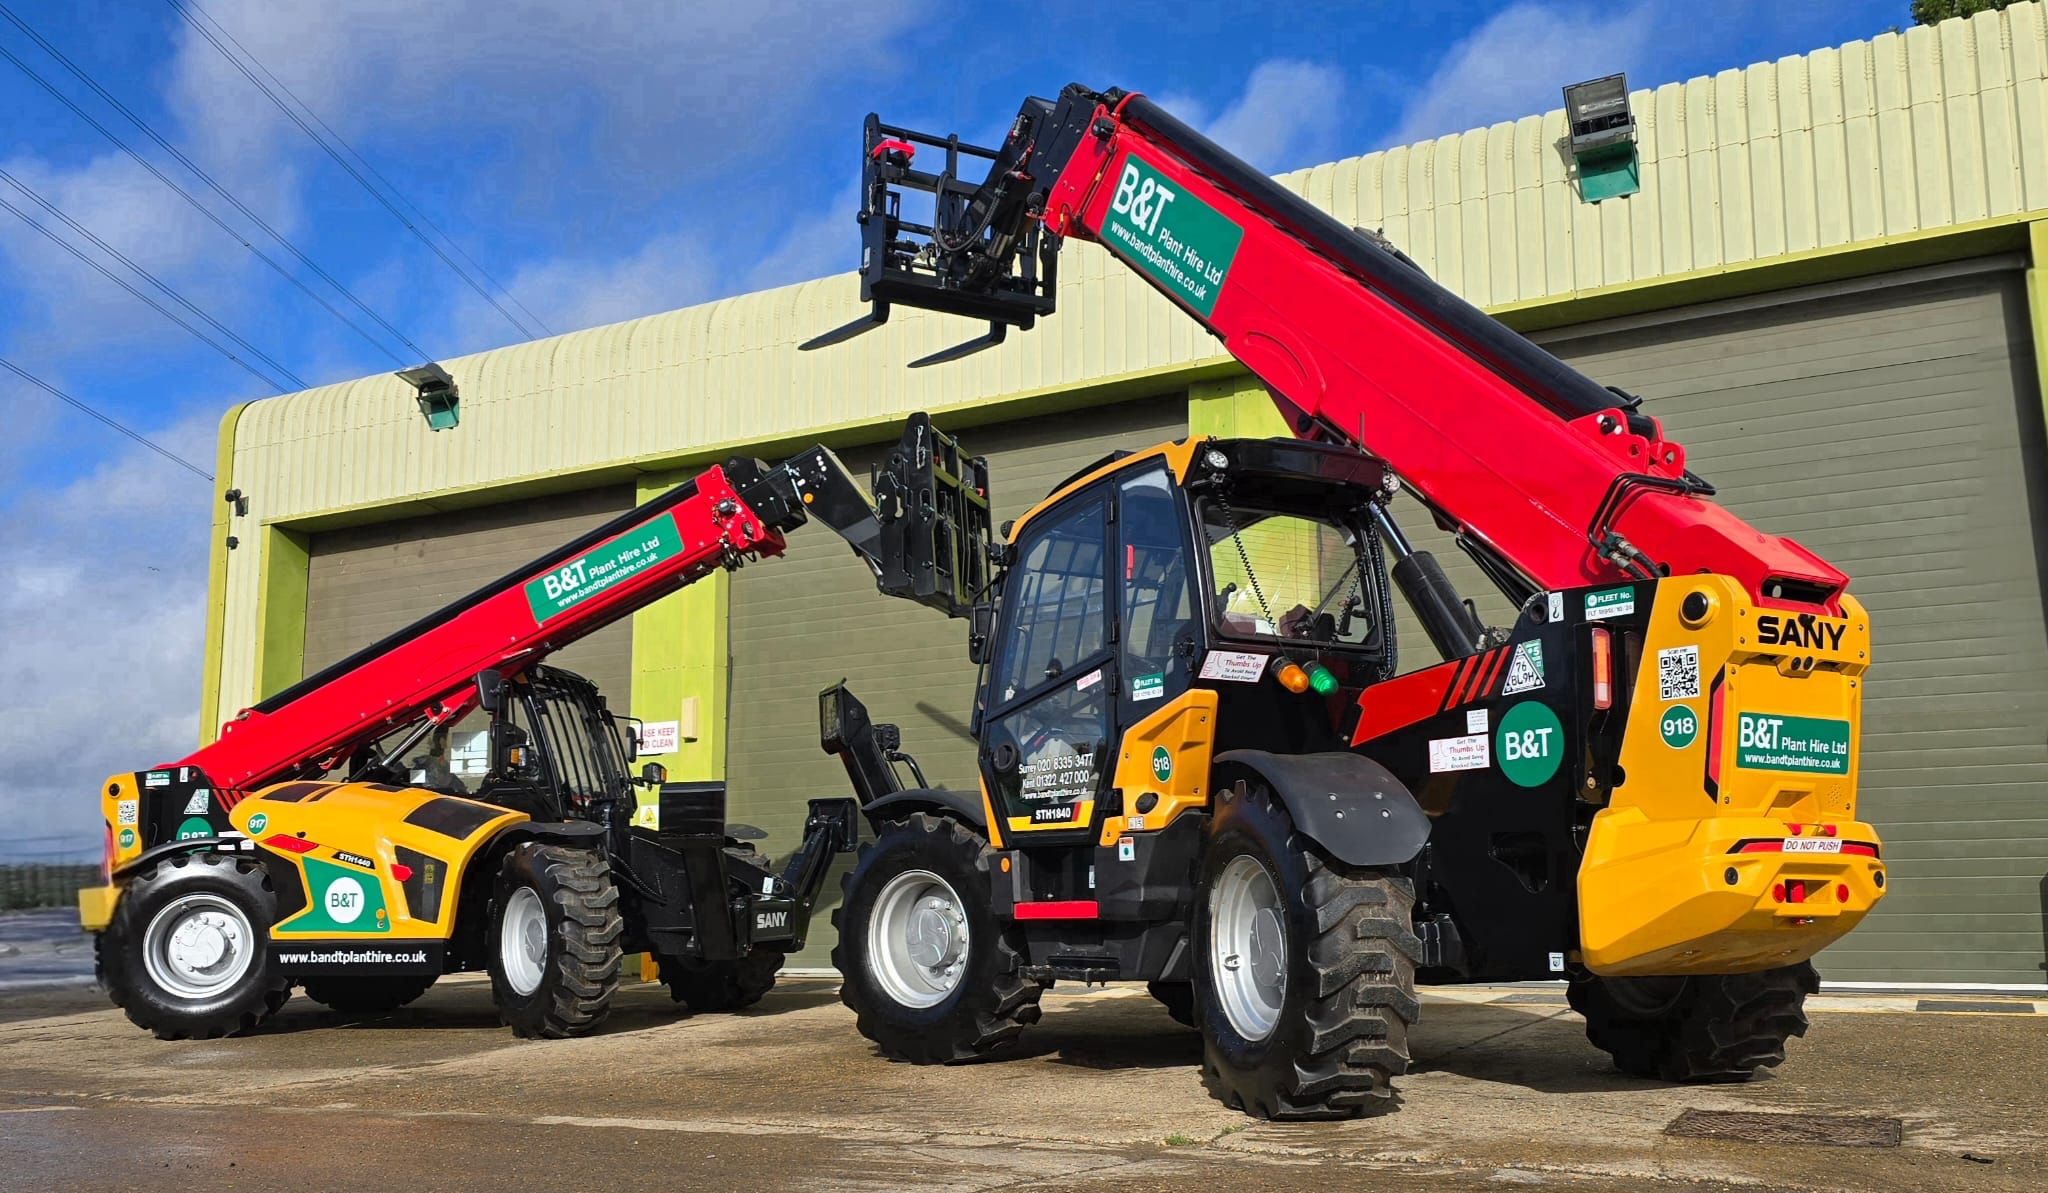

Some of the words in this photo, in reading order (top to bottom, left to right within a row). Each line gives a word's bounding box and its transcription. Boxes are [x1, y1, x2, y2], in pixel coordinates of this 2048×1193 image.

[1112, 163, 1175, 236] B&T
[1158, 227, 1184, 258] Plant
[1183, 246, 1204, 273] Hire
[1204, 261, 1224, 286] Ltd
[1111, 221, 1208, 301] www.bandtplanthire.co.uk
[543, 559, 587, 600] B&T
[588, 560, 618, 580] Plant
[617, 547, 641, 565] Hire
[641, 536, 661, 553] Ltd
[557, 551, 659, 608] www.bandtplanthire.co.uk
[1597, 593, 1619, 603] FLEET
[1757, 615, 1847, 651] SANY
[657, 726, 676, 737] KEEP
[1663, 717, 1695, 736] 918
[651, 738, 674, 749] CLEAN
[1740, 716, 1784, 750] B&T
[1781, 736, 1807, 752] Plant
[1809, 738, 1830, 754] Hire
[1831, 740, 1847, 755] Ltd
[1505, 728, 1553, 761] B&T
[1018, 763, 1037, 774] Surrey
[1037, 759, 1051, 771] 020
[1053, 756, 1073, 770] 8335
[1074, 753, 1093, 767] 3477
[1153, 757, 1170, 771] 918
[1744, 753, 1841, 769] www.bandtplanthire.co.uk
[1022, 778, 1036, 788] Kent
[1036, 773, 1057, 787] 01322
[1059, 771, 1073, 785] 427
[1074, 769, 1090, 783] 000
[1035, 808, 1071, 819] STH1840
[248, 818, 266, 829] 917
[119, 834, 134, 844] 917
[1785, 840, 1799, 850] DO
[1800, 841, 1817, 850] NOT
[1818, 841, 1840, 851] PUSH
[338, 853, 371, 868] STH1440
[330, 893, 358, 908] B&T
[756, 911, 788, 929] SANY
[279, 950, 427, 965] www.bandtplanthire.co.uk
